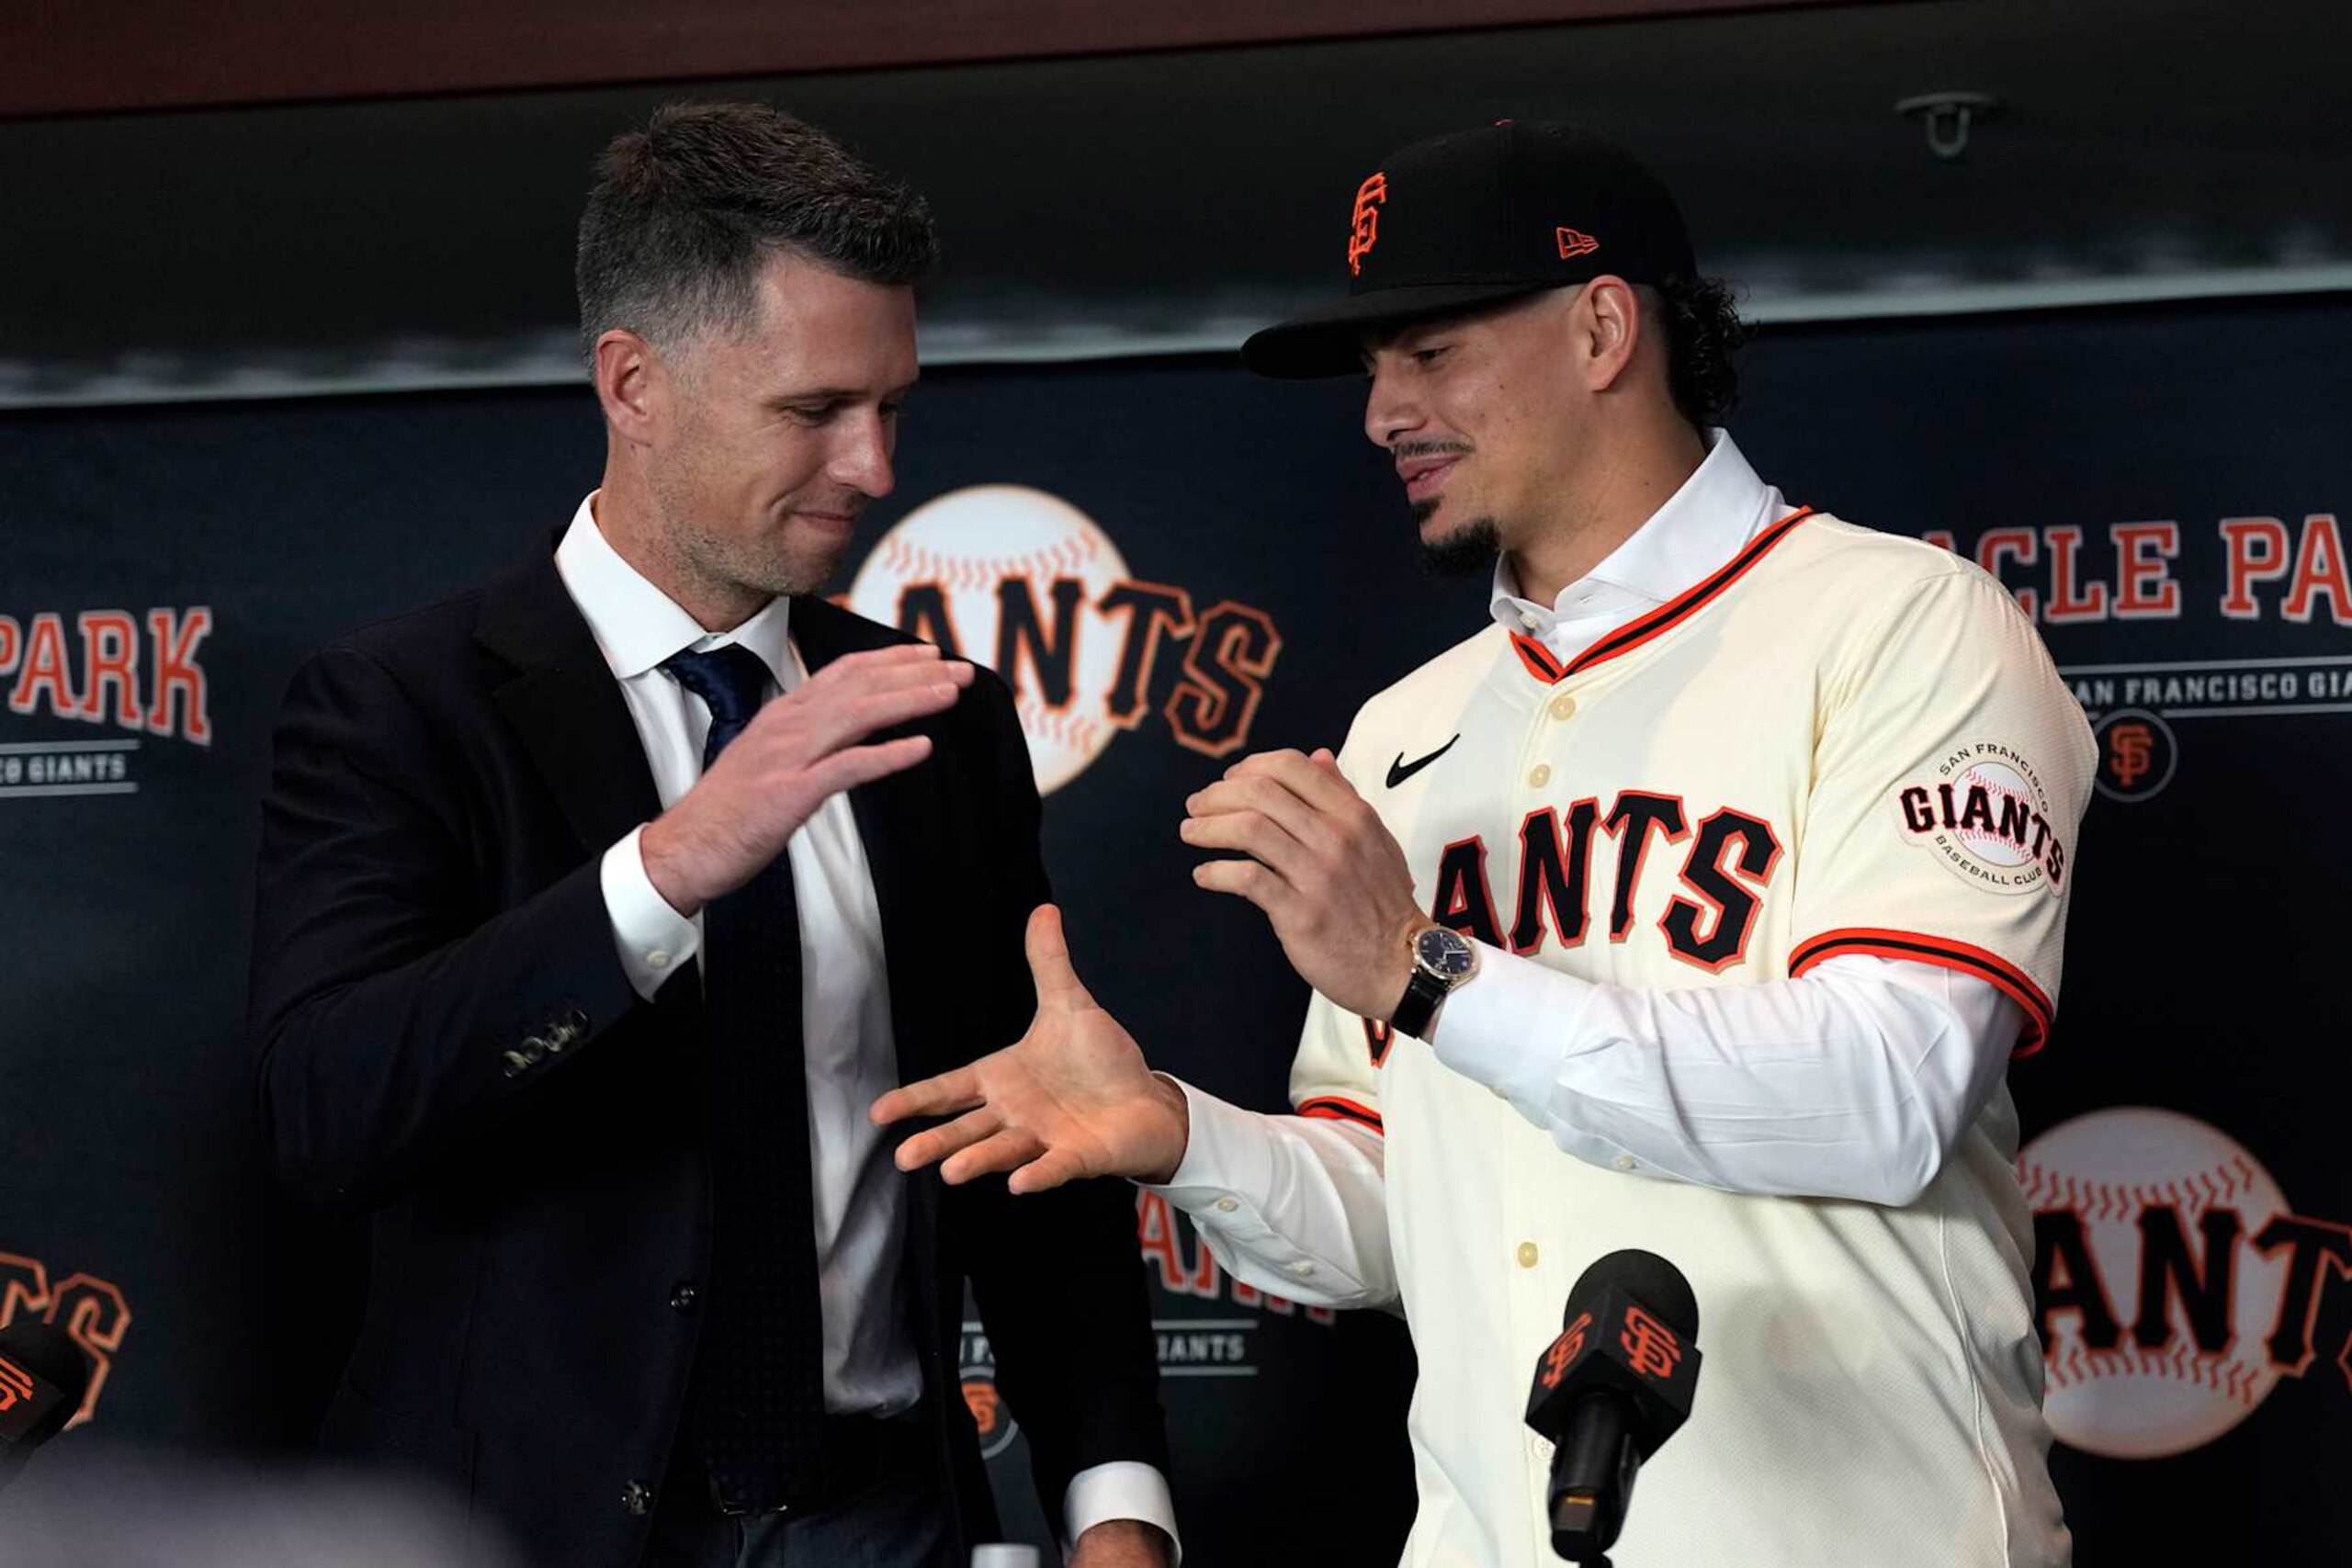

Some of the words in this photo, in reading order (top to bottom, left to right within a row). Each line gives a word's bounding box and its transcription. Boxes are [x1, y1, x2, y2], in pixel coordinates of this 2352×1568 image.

[1923, 520, 2182, 626] CLE
[827, 573, 1283, 759] ANTS
[2075, 679, 2114, 705] AN
[2125, 672, 2298, 705] FRANCISCO
[28, 752, 126, 784] GIANTS
[1939, 747, 1972, 775] SAN
[1975, 743, 2049, 813] FRANCISCO
[1898, 783, 2066, 886] GIANTS
[1934, 835, 2010, 886] BASEBALL
[2014, 866, 2042, 886] CLUB
[2030, 1204, 2352, 1392] ANT
